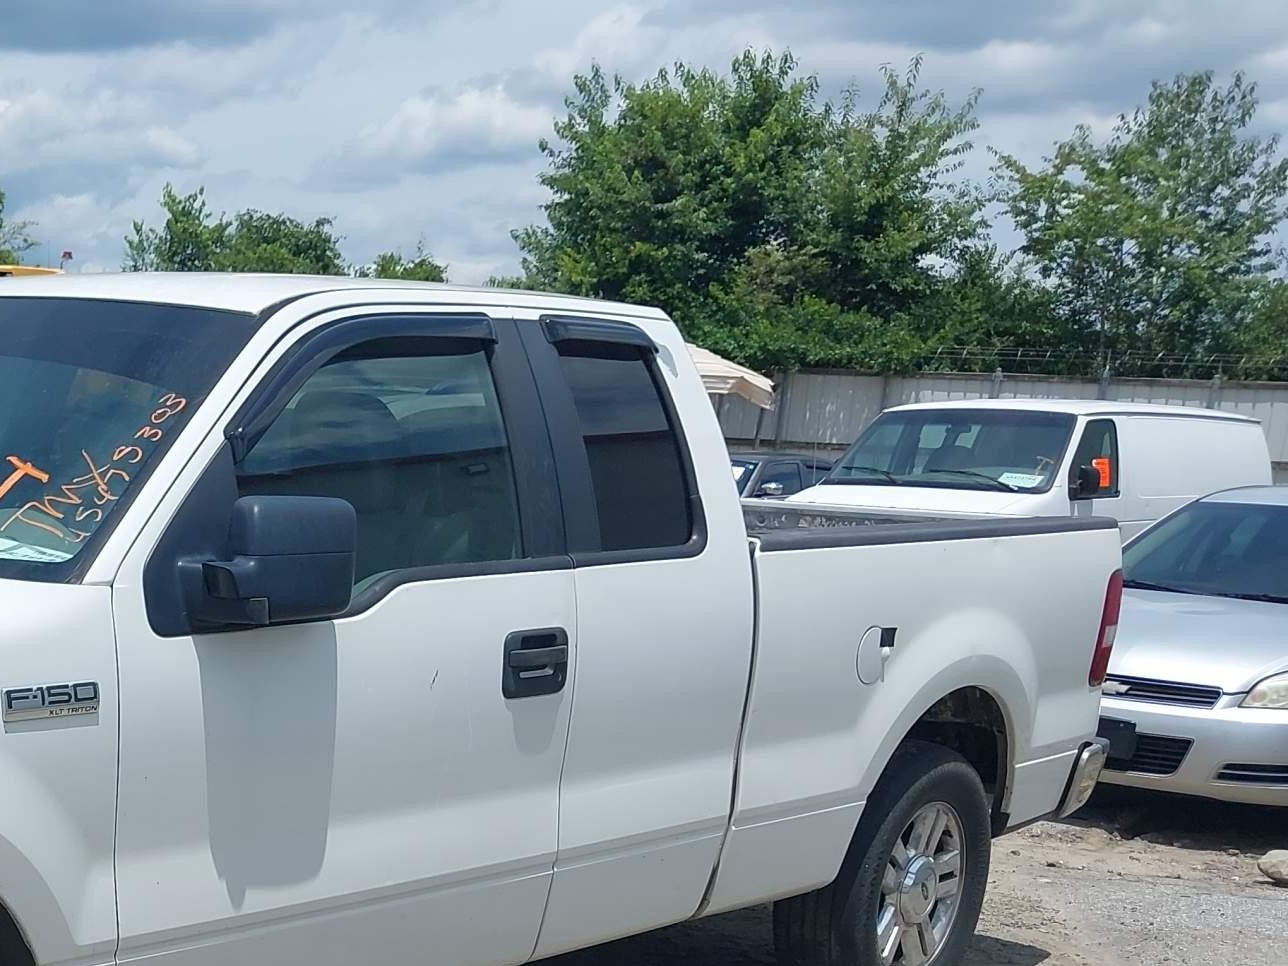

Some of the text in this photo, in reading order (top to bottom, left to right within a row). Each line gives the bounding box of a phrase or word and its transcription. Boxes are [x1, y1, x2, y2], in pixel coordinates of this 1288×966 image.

[4, 681, 99, 710] F-150
[48, 705, 99, 717] XLT TRITON
